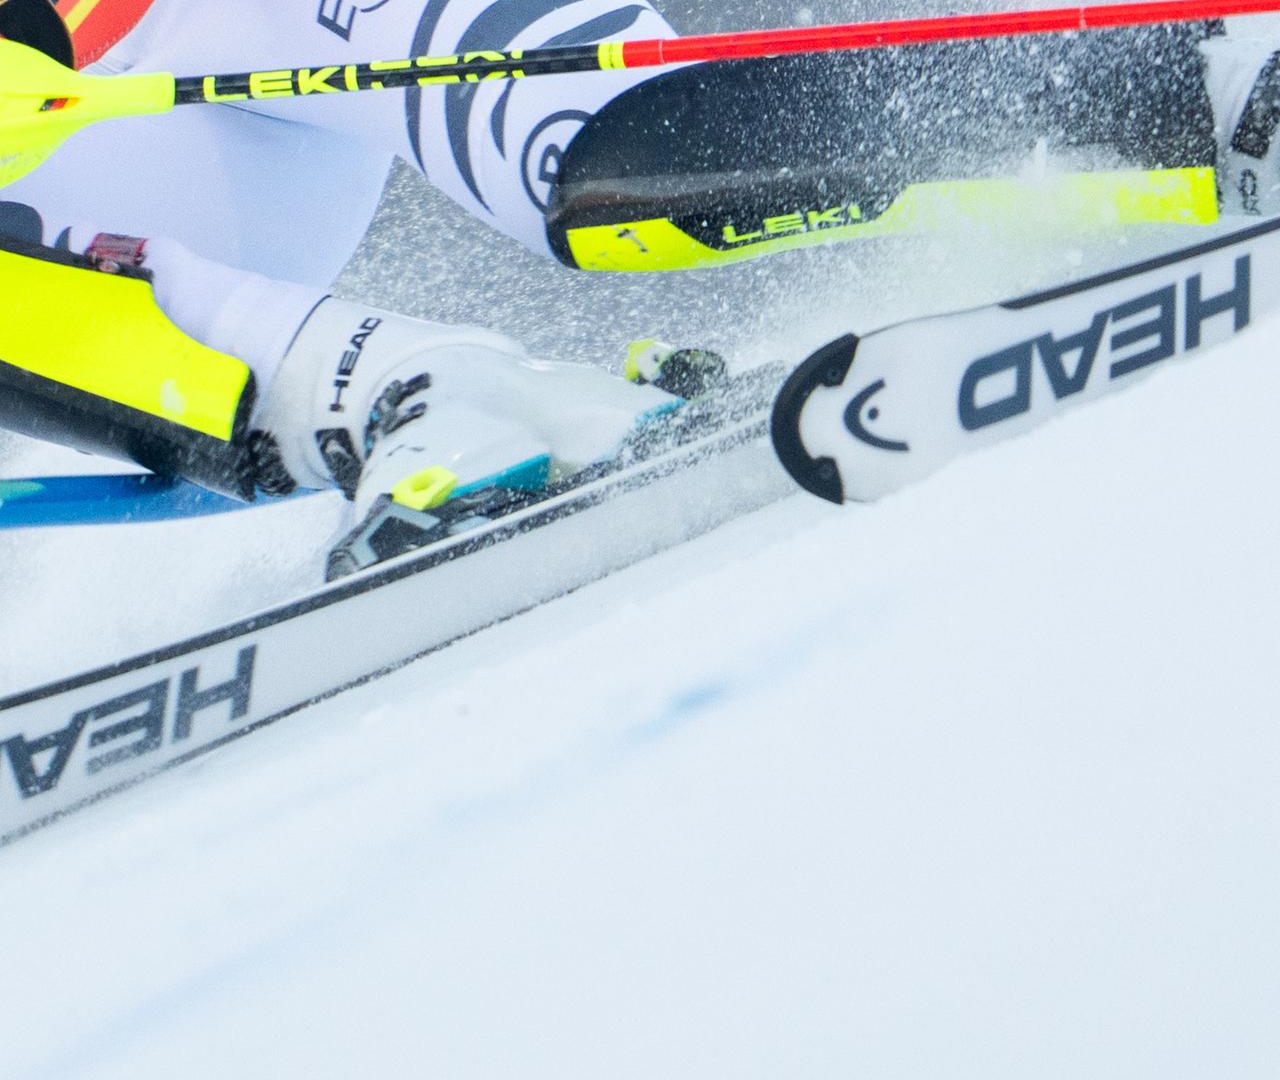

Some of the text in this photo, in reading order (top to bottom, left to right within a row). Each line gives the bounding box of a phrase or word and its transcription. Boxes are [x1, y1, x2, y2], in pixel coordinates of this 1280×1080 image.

[203, 65, 360, 102] LEKI
[723, 204, 862, 244] LEKI
[328, 317, 384, 413] HEAD
[958, 253, 1252, 431] HEAD
